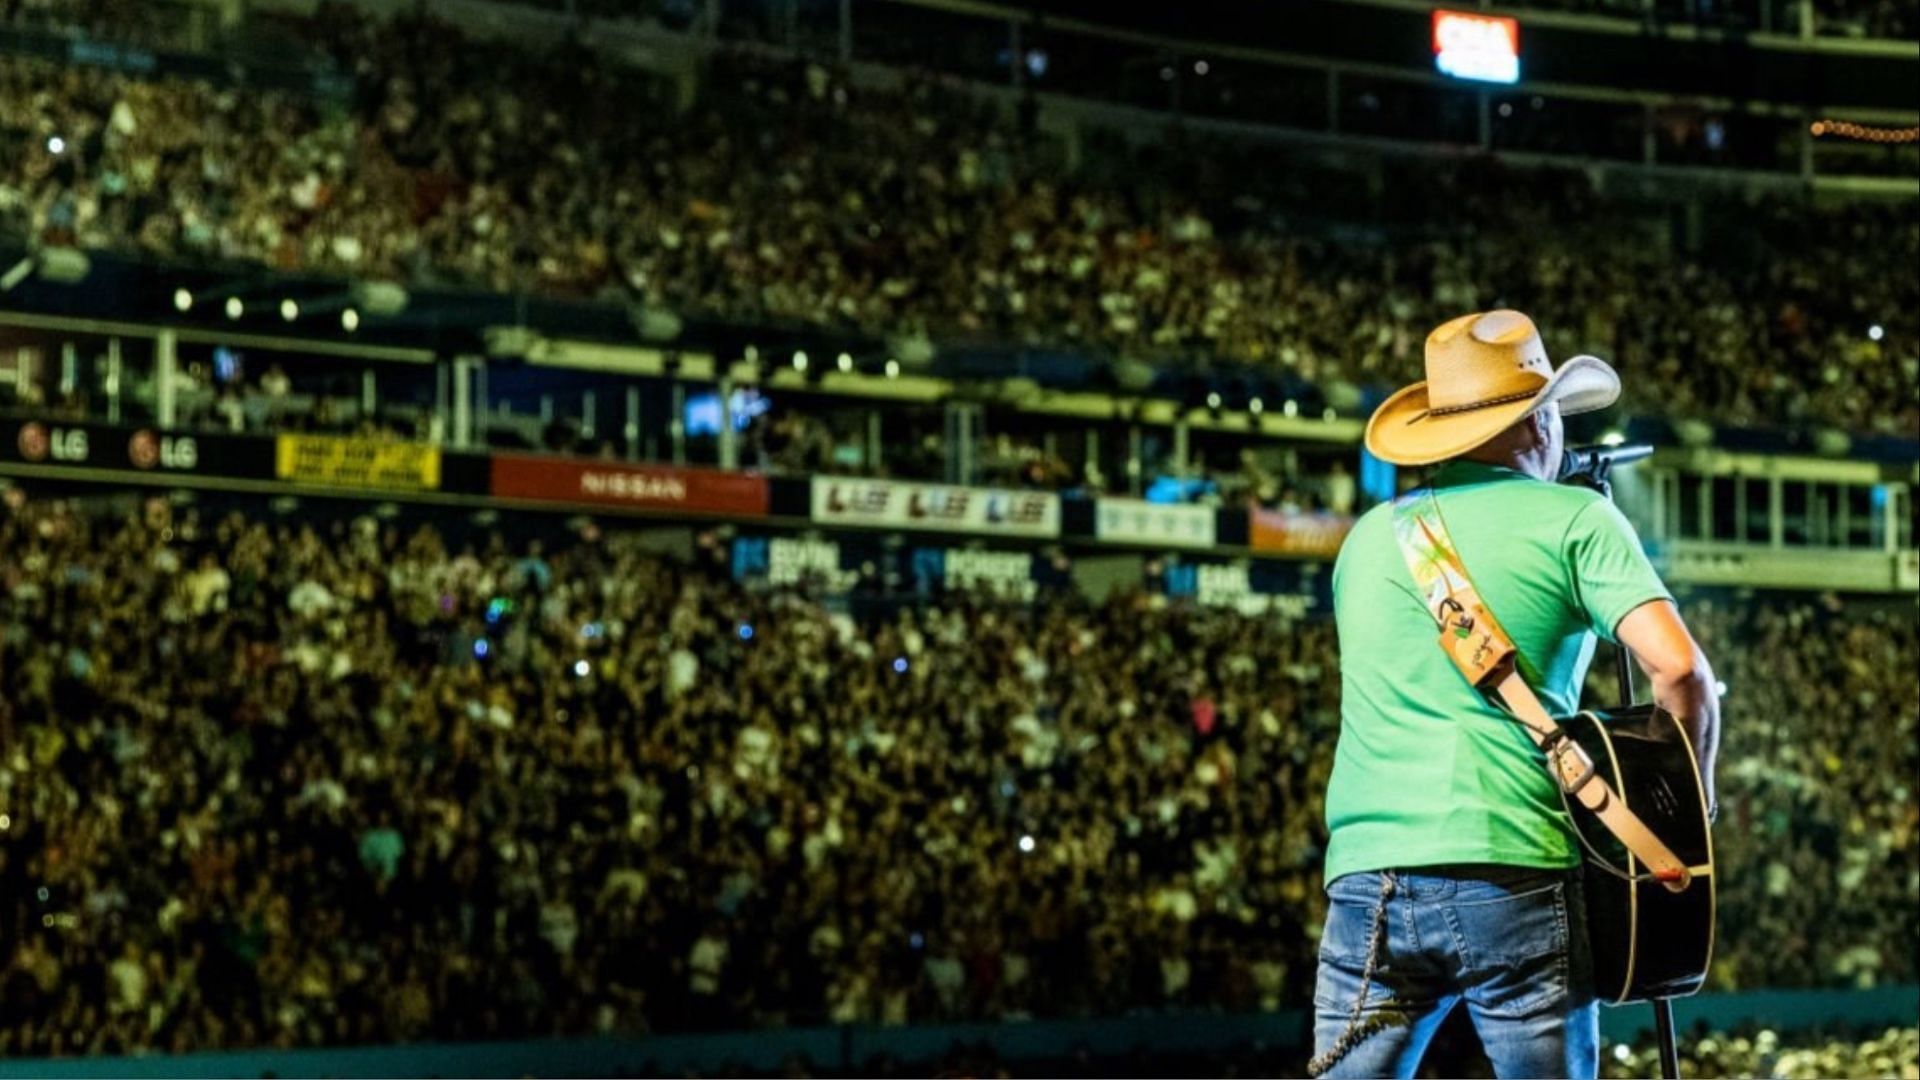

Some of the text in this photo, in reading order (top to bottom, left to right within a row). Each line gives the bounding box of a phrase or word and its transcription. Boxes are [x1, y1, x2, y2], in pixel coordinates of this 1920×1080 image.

[51, 427, 89, 461] LG
[160, 436, 198, 469] LG
[580, 471, 686, 500] NISSAN
